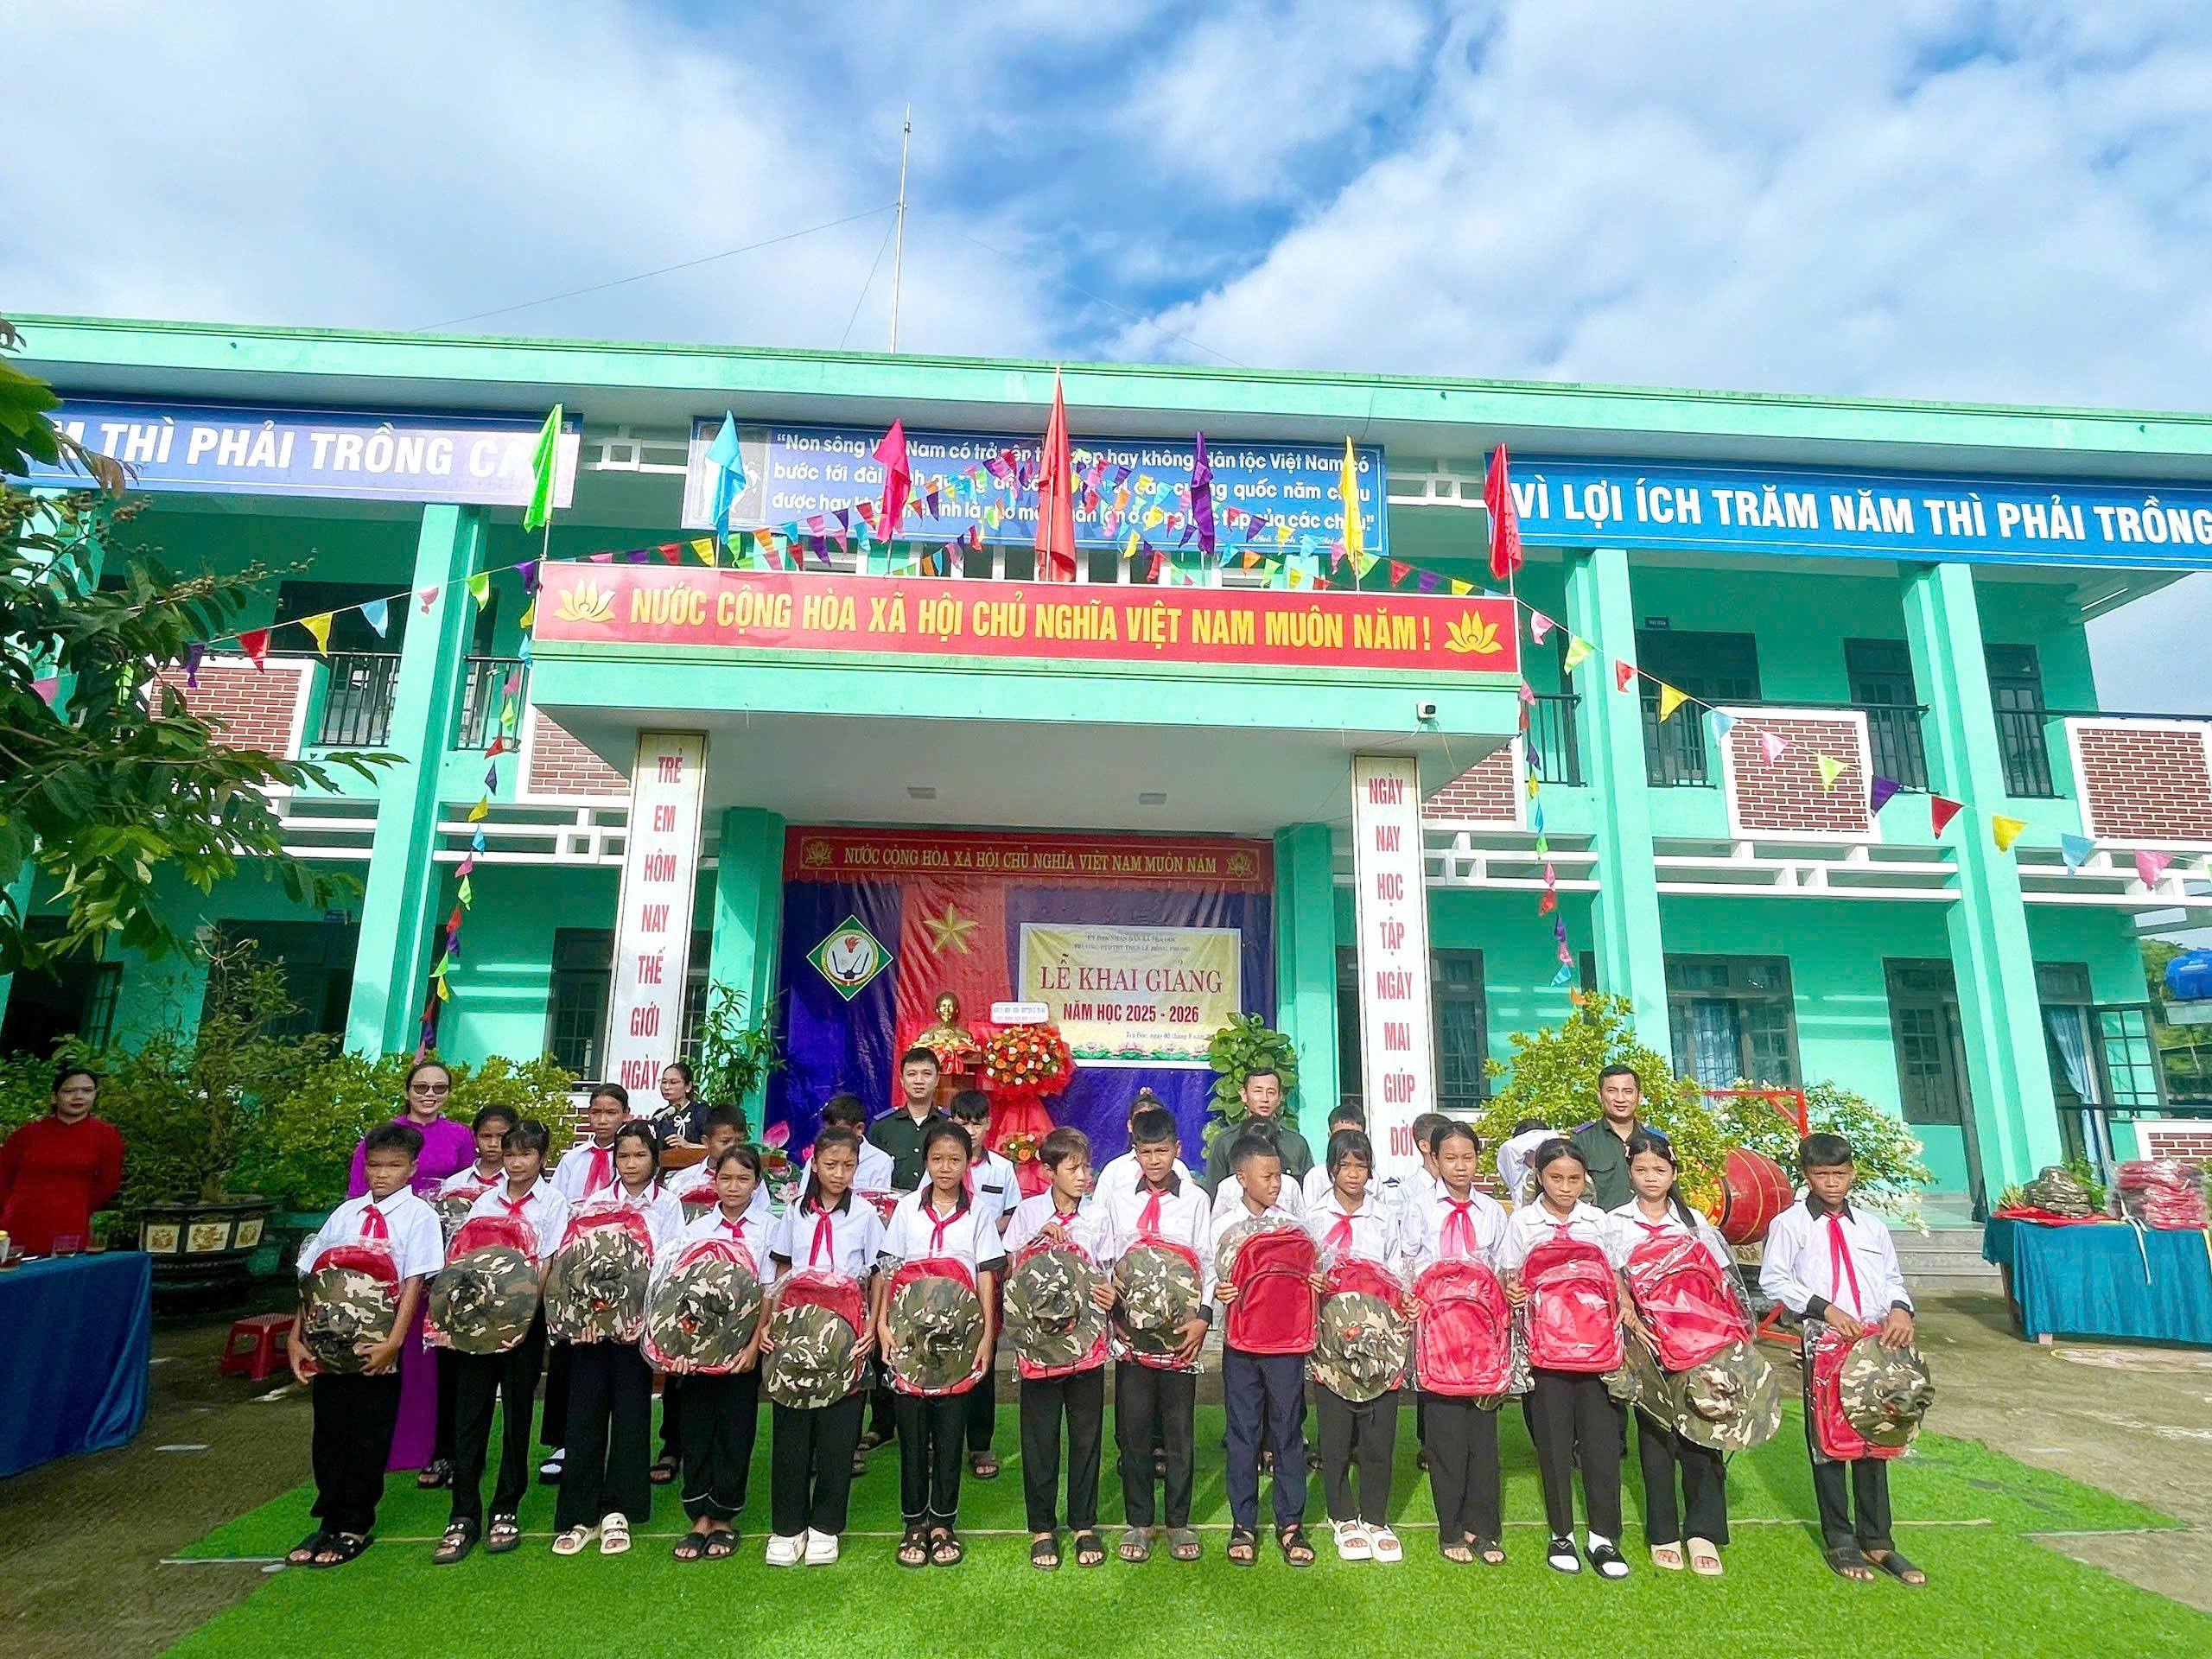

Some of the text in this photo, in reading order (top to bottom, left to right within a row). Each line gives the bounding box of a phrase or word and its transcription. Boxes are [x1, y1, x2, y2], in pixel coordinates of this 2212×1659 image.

[101, 416, 174, 463] THÌ
[187, 419, 293, 469] PHẢI
[309, 422, 454, 476] TRỒNG
[823, 435, 865, 458] sông
[906, 441, 945, 458] Nam
[950, 442, 971, 460] có
[974, 442, 998, 460] trở
[1107, 449, 1139, 468] hay
[1239, 452, 1267, 474] tộc
[1269, 452, 1302, 474] Việt
[1305, 454, 1342, 471] Nam
[774, 462, 819, 480] bước
[825, 464, 849, 482] tới
[854, 466, 883, 484] đài
[1234, 478, 1277, 501] quốc
[1284, 482, 1321, 499] năm
[772, 492, 817, 513] được
[819, 494, 851, 512] hay
[1287, 510, 1320, 530] các
[1510, 475, 2212, 545] VÌ LỢI ÍCH TRĂM NĂM THÌ PHẢI TRỒNG
[631, 582, 705, 627] NƯỚC
[716, 586, 791, 635] CỘNG
[802, 587, 856, 632] HÒA
[868, 591, 906, 634] XÃ
[918, 592, 962, 642] HỘI
[972, 590, 1027, 638] CHỦ
[1035, 598, 1118, 643] NGHĨA
[1125, 601, 1182, 651] VIỆT
[1192, 609, 1255, 645] NAM
[1265, 604, 1344, 648] MUÔN
[658, 747, 683, 784] TRẺ
[1369, 773, 1403, 804] NGÀY
[653, 805, 676, 832] EM
[1376, 825, 1401, 852] NAY
[644, 849, 677, 882] HÔM
[843, 843, 880, 864] NƯỚC
[1111, 855, 1141, 871] NAM
[1376, 873, 1403, 906] HỌC
[641, 905, 670, 932] NAY
[1380, 916, 1405, 956] TẬP
[638, 946, 665, 984] THẾ
[1040, 953, 1223, 994] LỄ KHAI GIẢNG
[1376, 966, 1412, 1000] NGÀY
[630, 1001, 660, 1037] GIỚI
[1063, 1001, 1093, 1020] NĂM
[1097, 1004, 1122, 1025] HỌC
[1126, 1005, 1156, 1022] 2025
[1169, 1006, 1199, 1023] 2026
[1383, 1022, 1411, 1051] MAI
[620, 1054, 660, 1090] NGÀY
[1383, 1068, 1415, 1103] GIÚP
